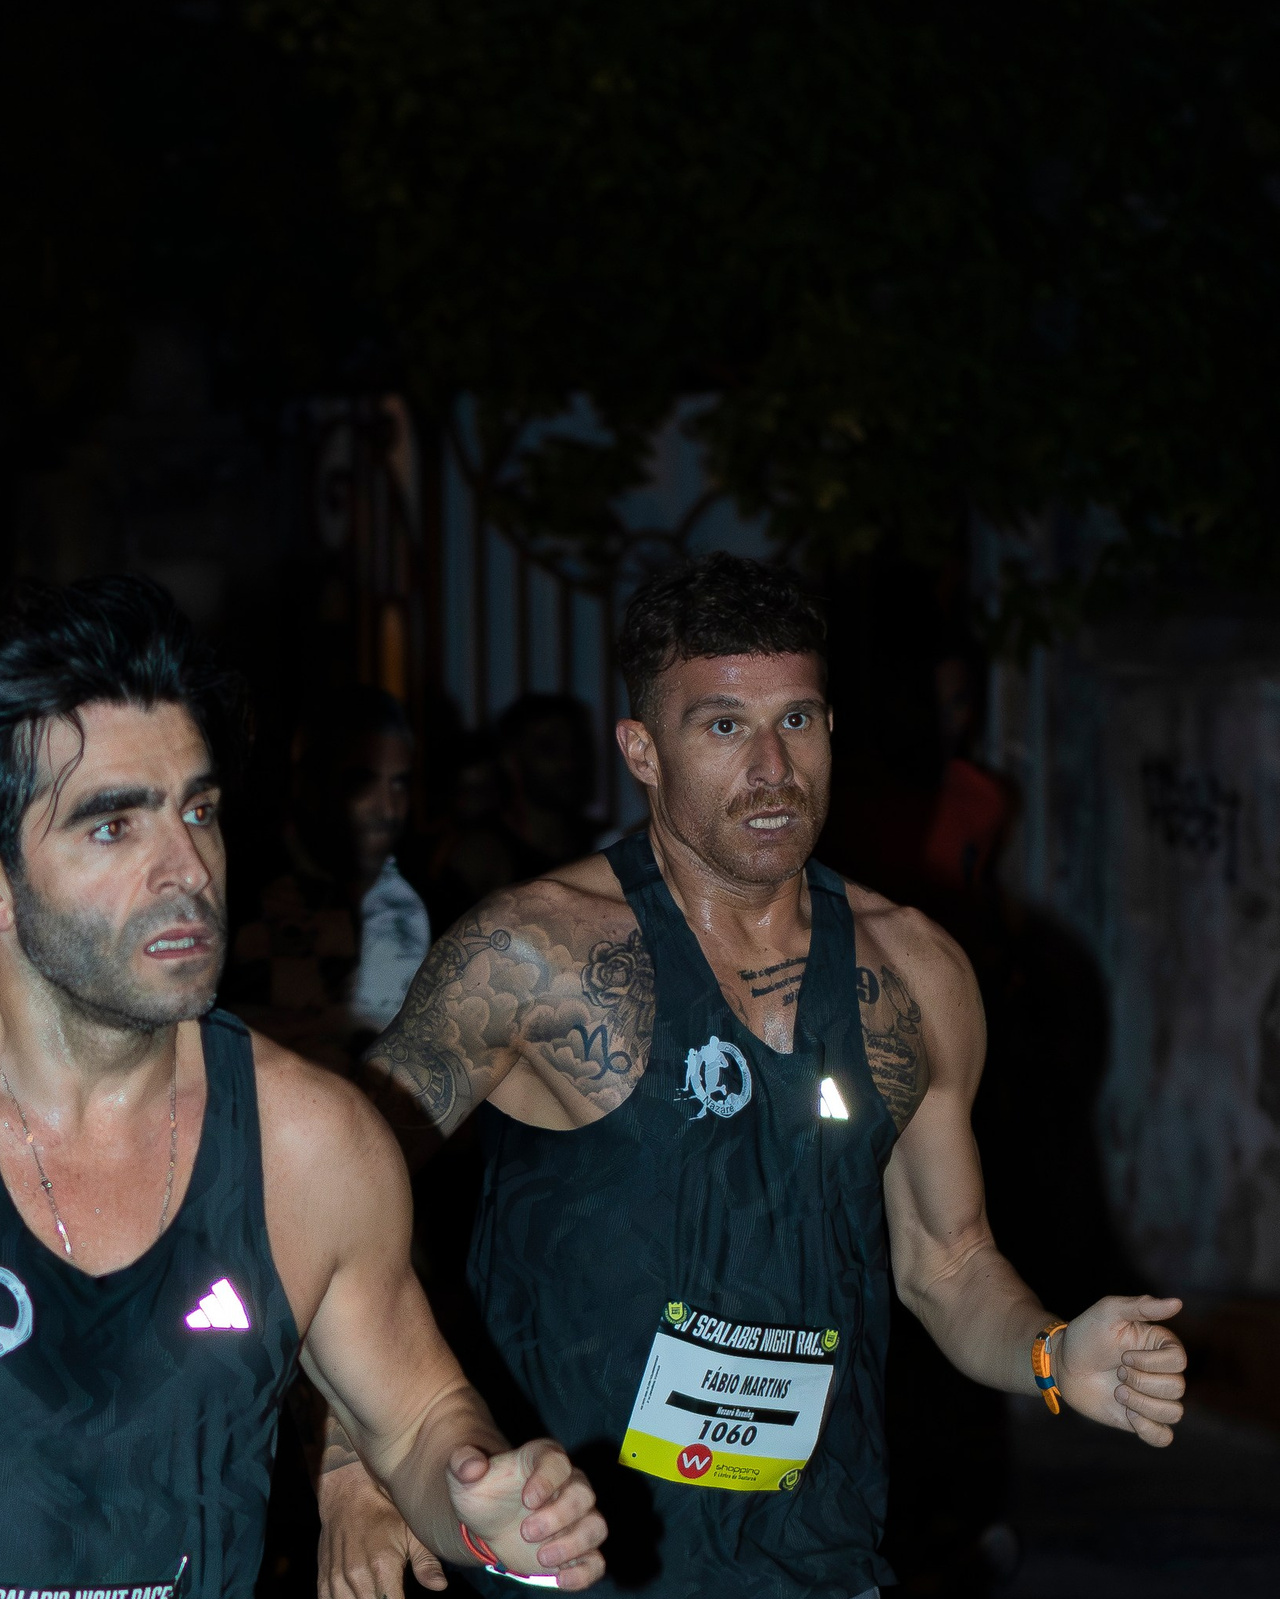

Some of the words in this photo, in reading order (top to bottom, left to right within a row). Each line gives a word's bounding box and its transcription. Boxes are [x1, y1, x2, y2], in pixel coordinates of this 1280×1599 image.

[693, 1314, 760, 1351] SCALABIS
[759, 1329, 796, 1354] NIGHT
[701, 1366, 740, 1395] FÁBIO
[740, 1375, 792, 1399] MARTINS
[698, 1419, 758, 1446] 1060
[682, 1452, 710, 1471] W
[716, 1464, 760, 1476] shopping
